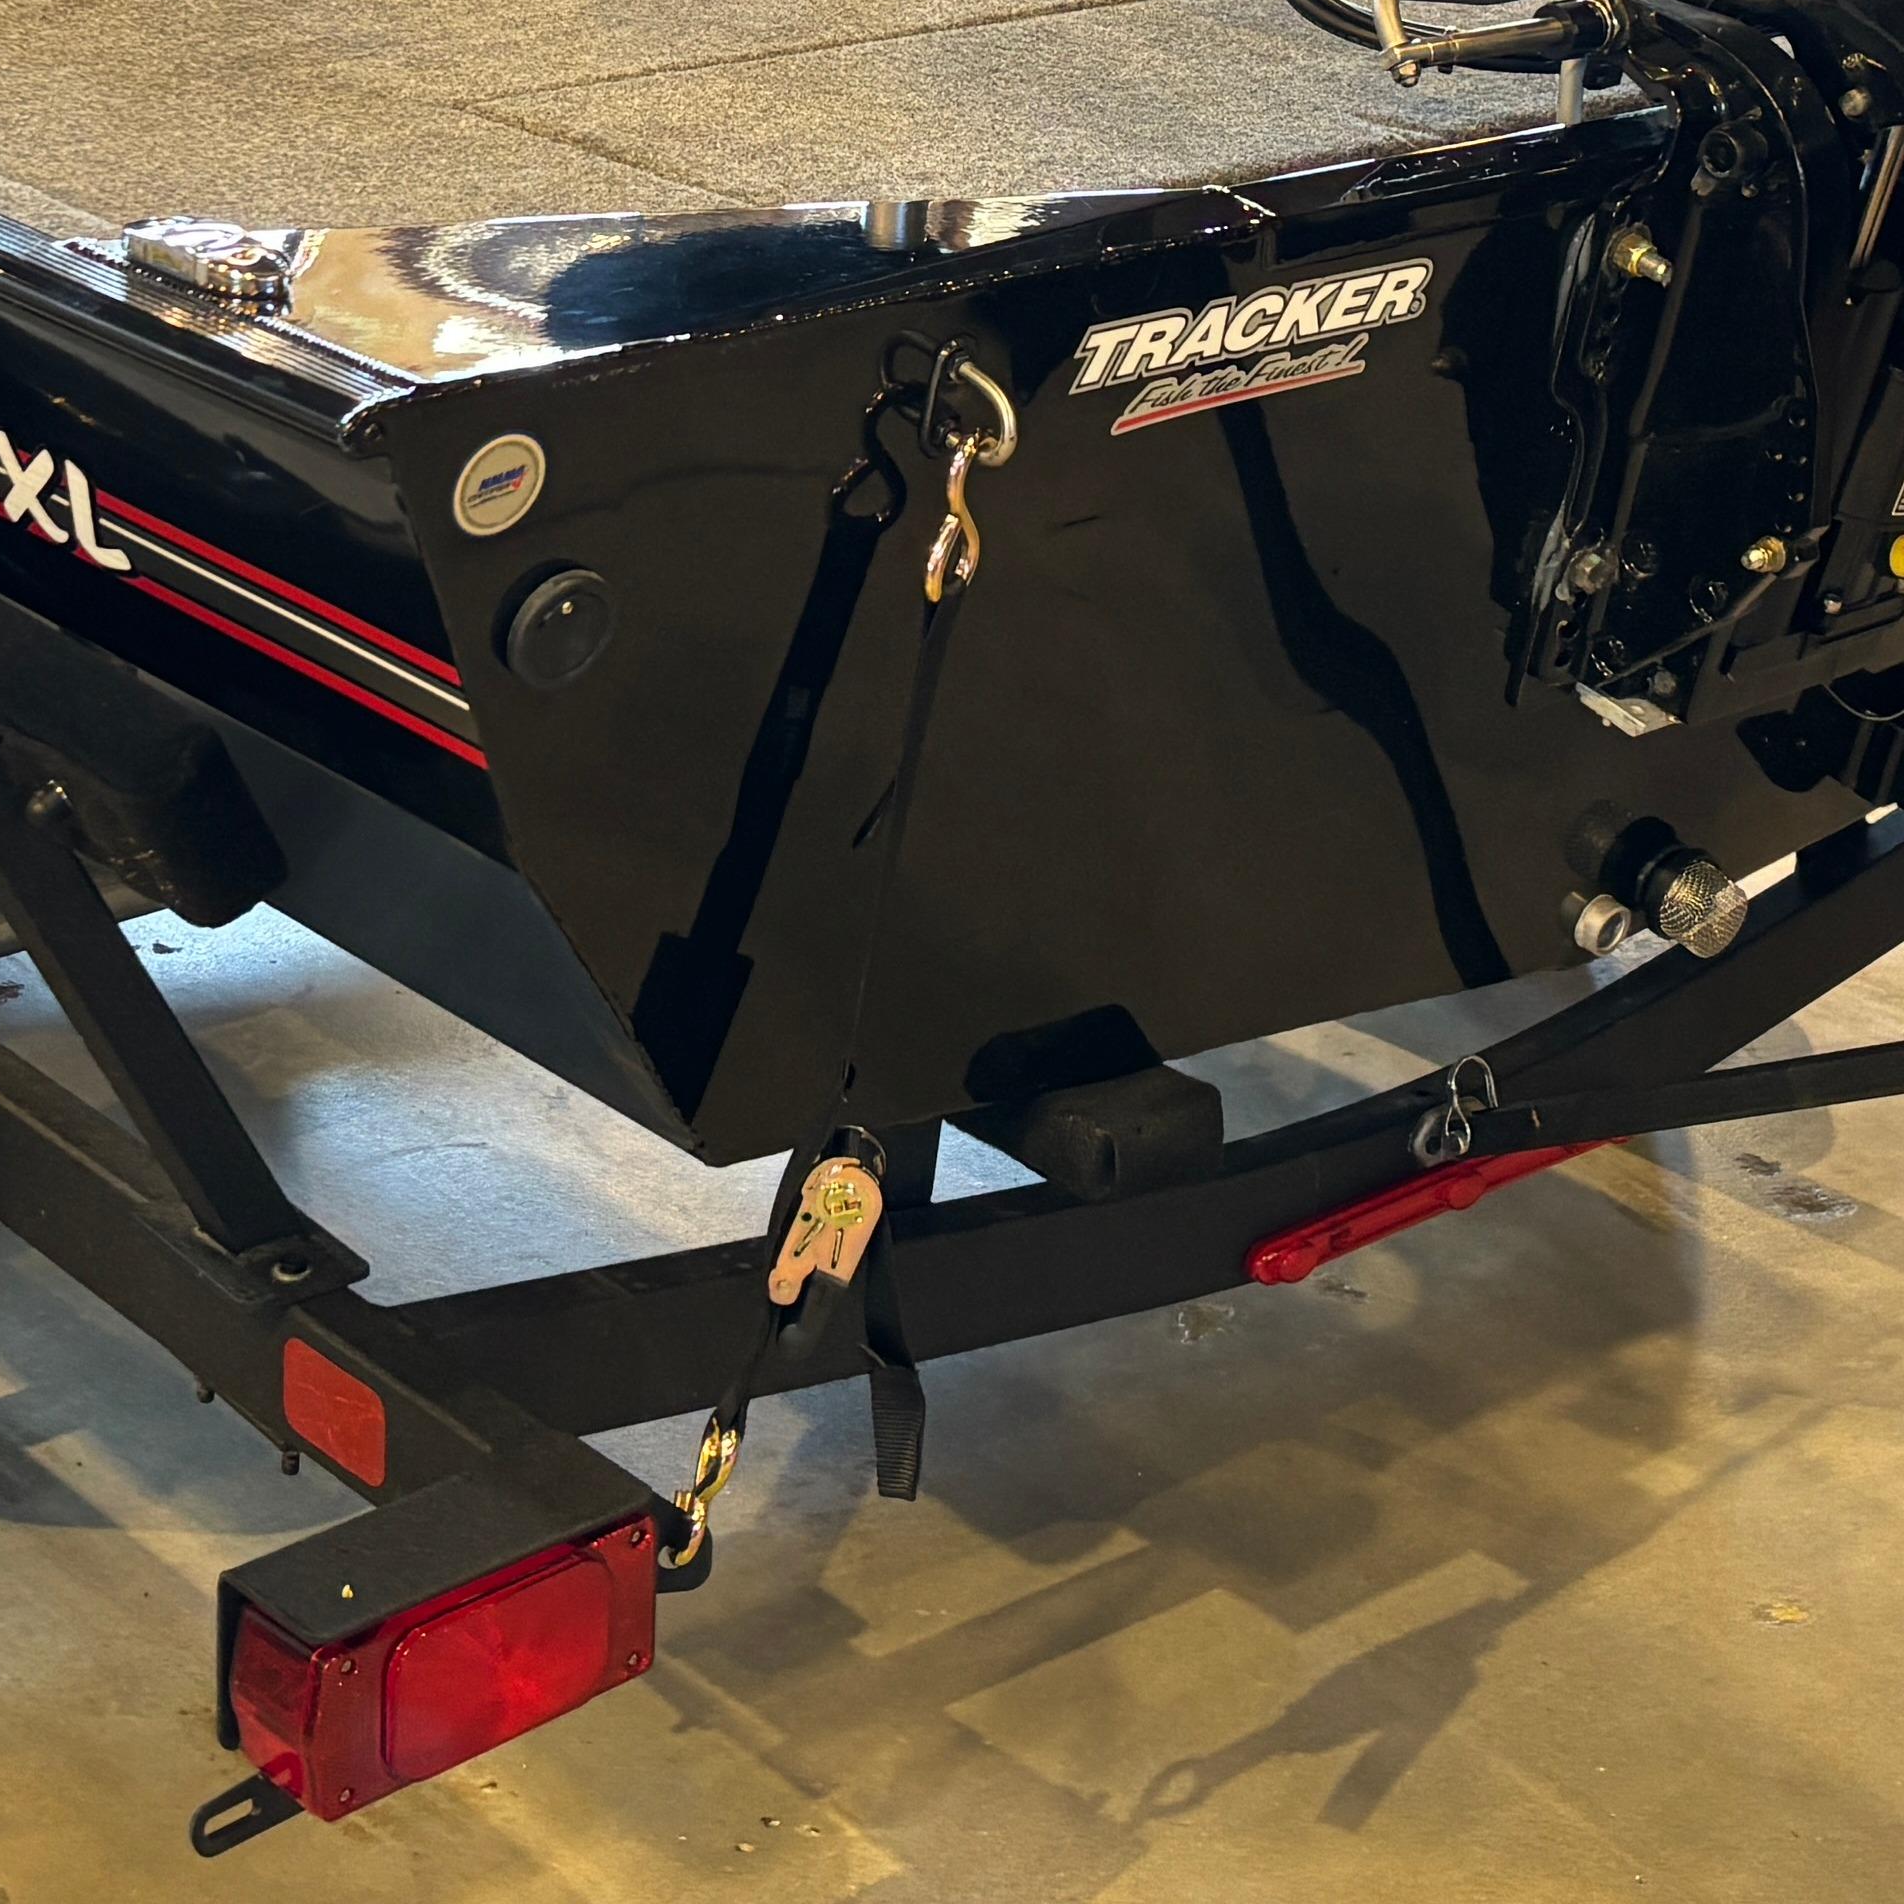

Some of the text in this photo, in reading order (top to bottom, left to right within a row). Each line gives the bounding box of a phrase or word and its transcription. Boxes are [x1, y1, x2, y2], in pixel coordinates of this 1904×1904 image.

[1079, 266, 1429, 387] TRACKER
[1130, 384, 1194, 414] Fish
[1201, 372, 1241, 398] the
